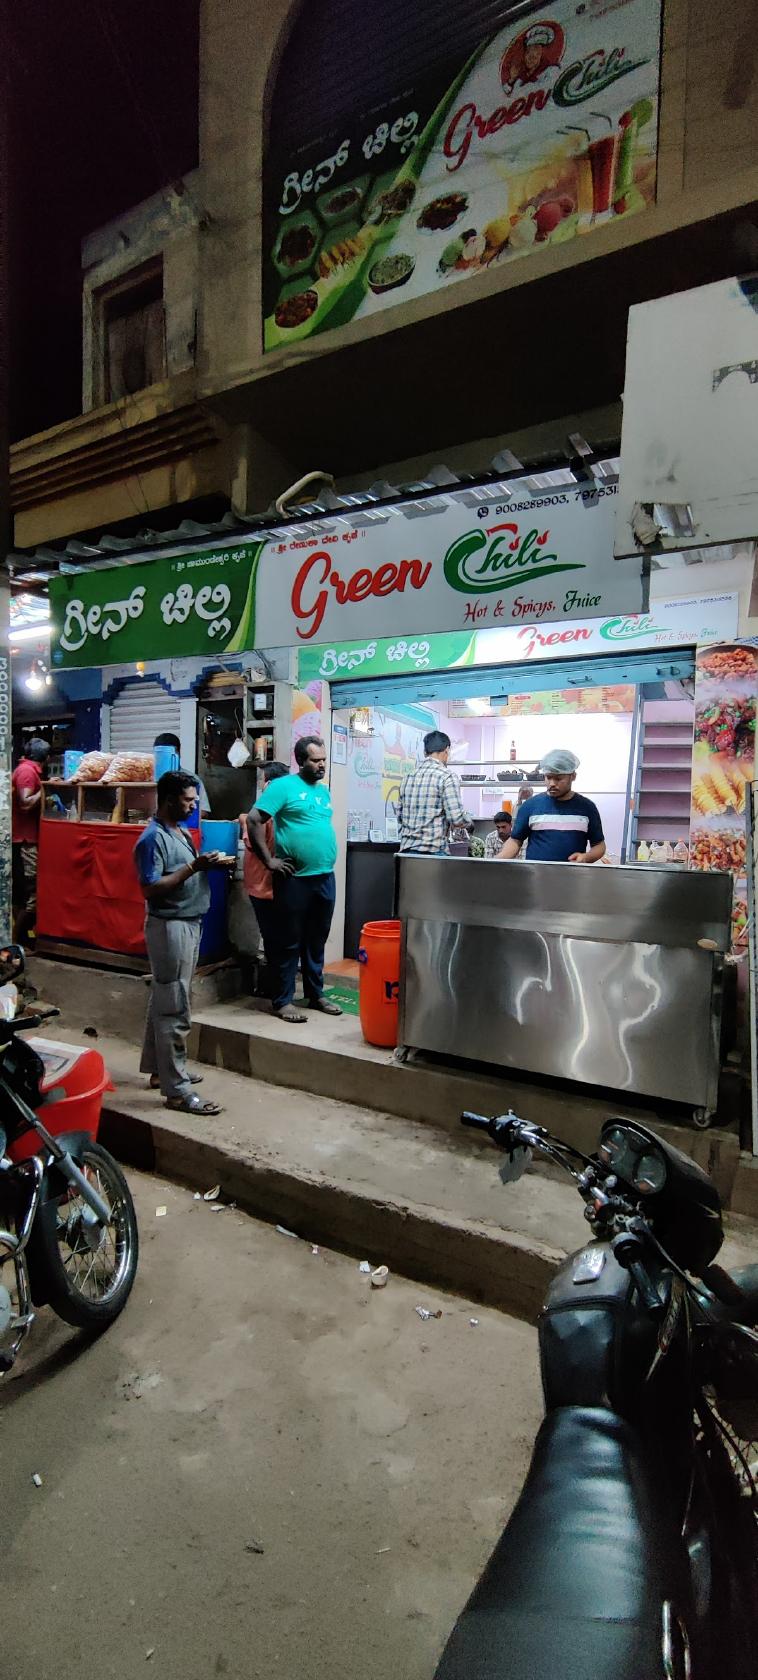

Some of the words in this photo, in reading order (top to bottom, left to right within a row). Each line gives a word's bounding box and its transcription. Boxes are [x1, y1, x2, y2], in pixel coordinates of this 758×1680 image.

[443, 89, 552, 172] Green
[278, 139, 350, 215] ಗ್ರೀನ್
[574, 485, 619, 501] 797531
[291, 551, 432, 639] Green
[443, 523, 586, 594] Chili
[463, 599, 487, 624] Hot
[493, 600, 505, 617] &
[562, 590, 602, 612] Juice
[59, 586, 147, 652] ಗ್ರೀನ್
[160, 583, 232, 641] ಚಿಲ್ಲಿ
[517, 626, 594, 659] Green
[319, 642, 377, 676] ಗ್ರೀನ್
[386, 641, 430, 668] ಚಿಲ್ಲಿ
